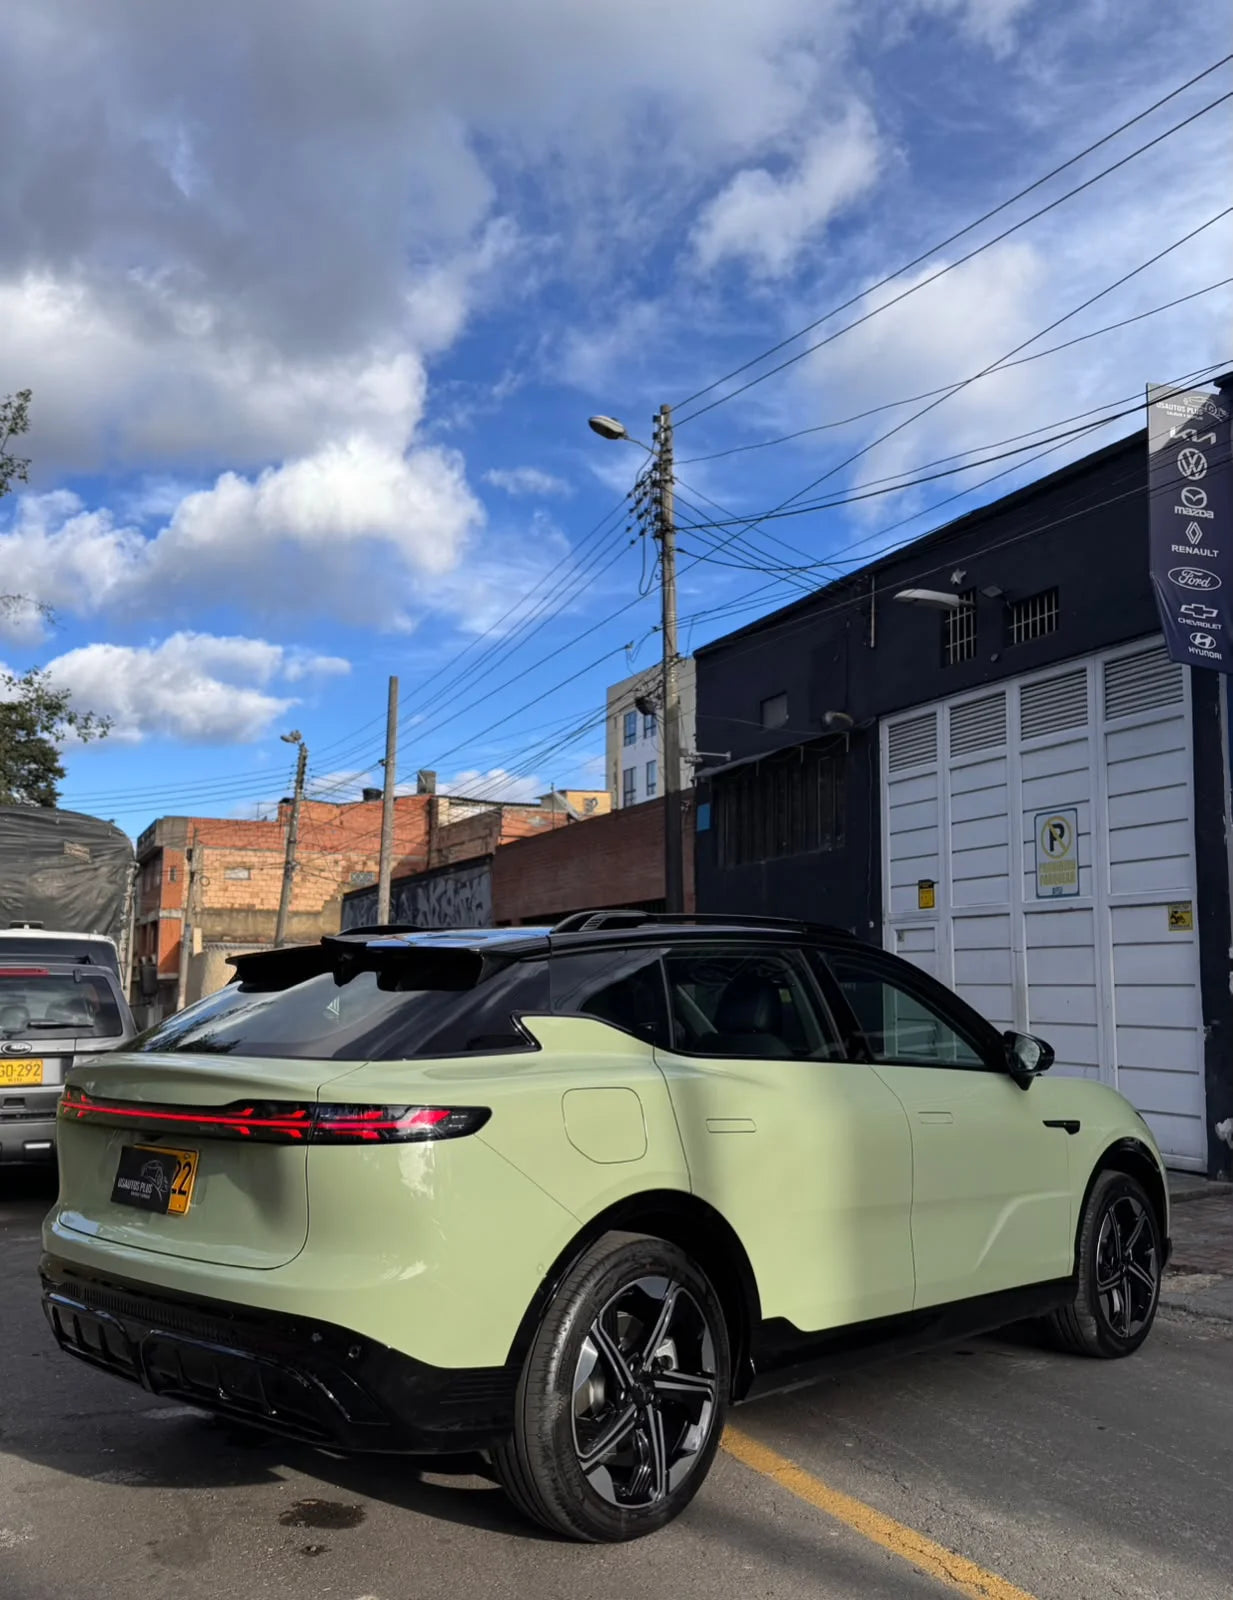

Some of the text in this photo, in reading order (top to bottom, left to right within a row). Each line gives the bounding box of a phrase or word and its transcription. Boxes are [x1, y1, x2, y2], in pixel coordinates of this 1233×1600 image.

[1171, 544, 1219, 557] RENAULT
[1177, 617, 1222, 630] CHEVROLET
[1188, 646, 1222, 660] HYUNDAI
